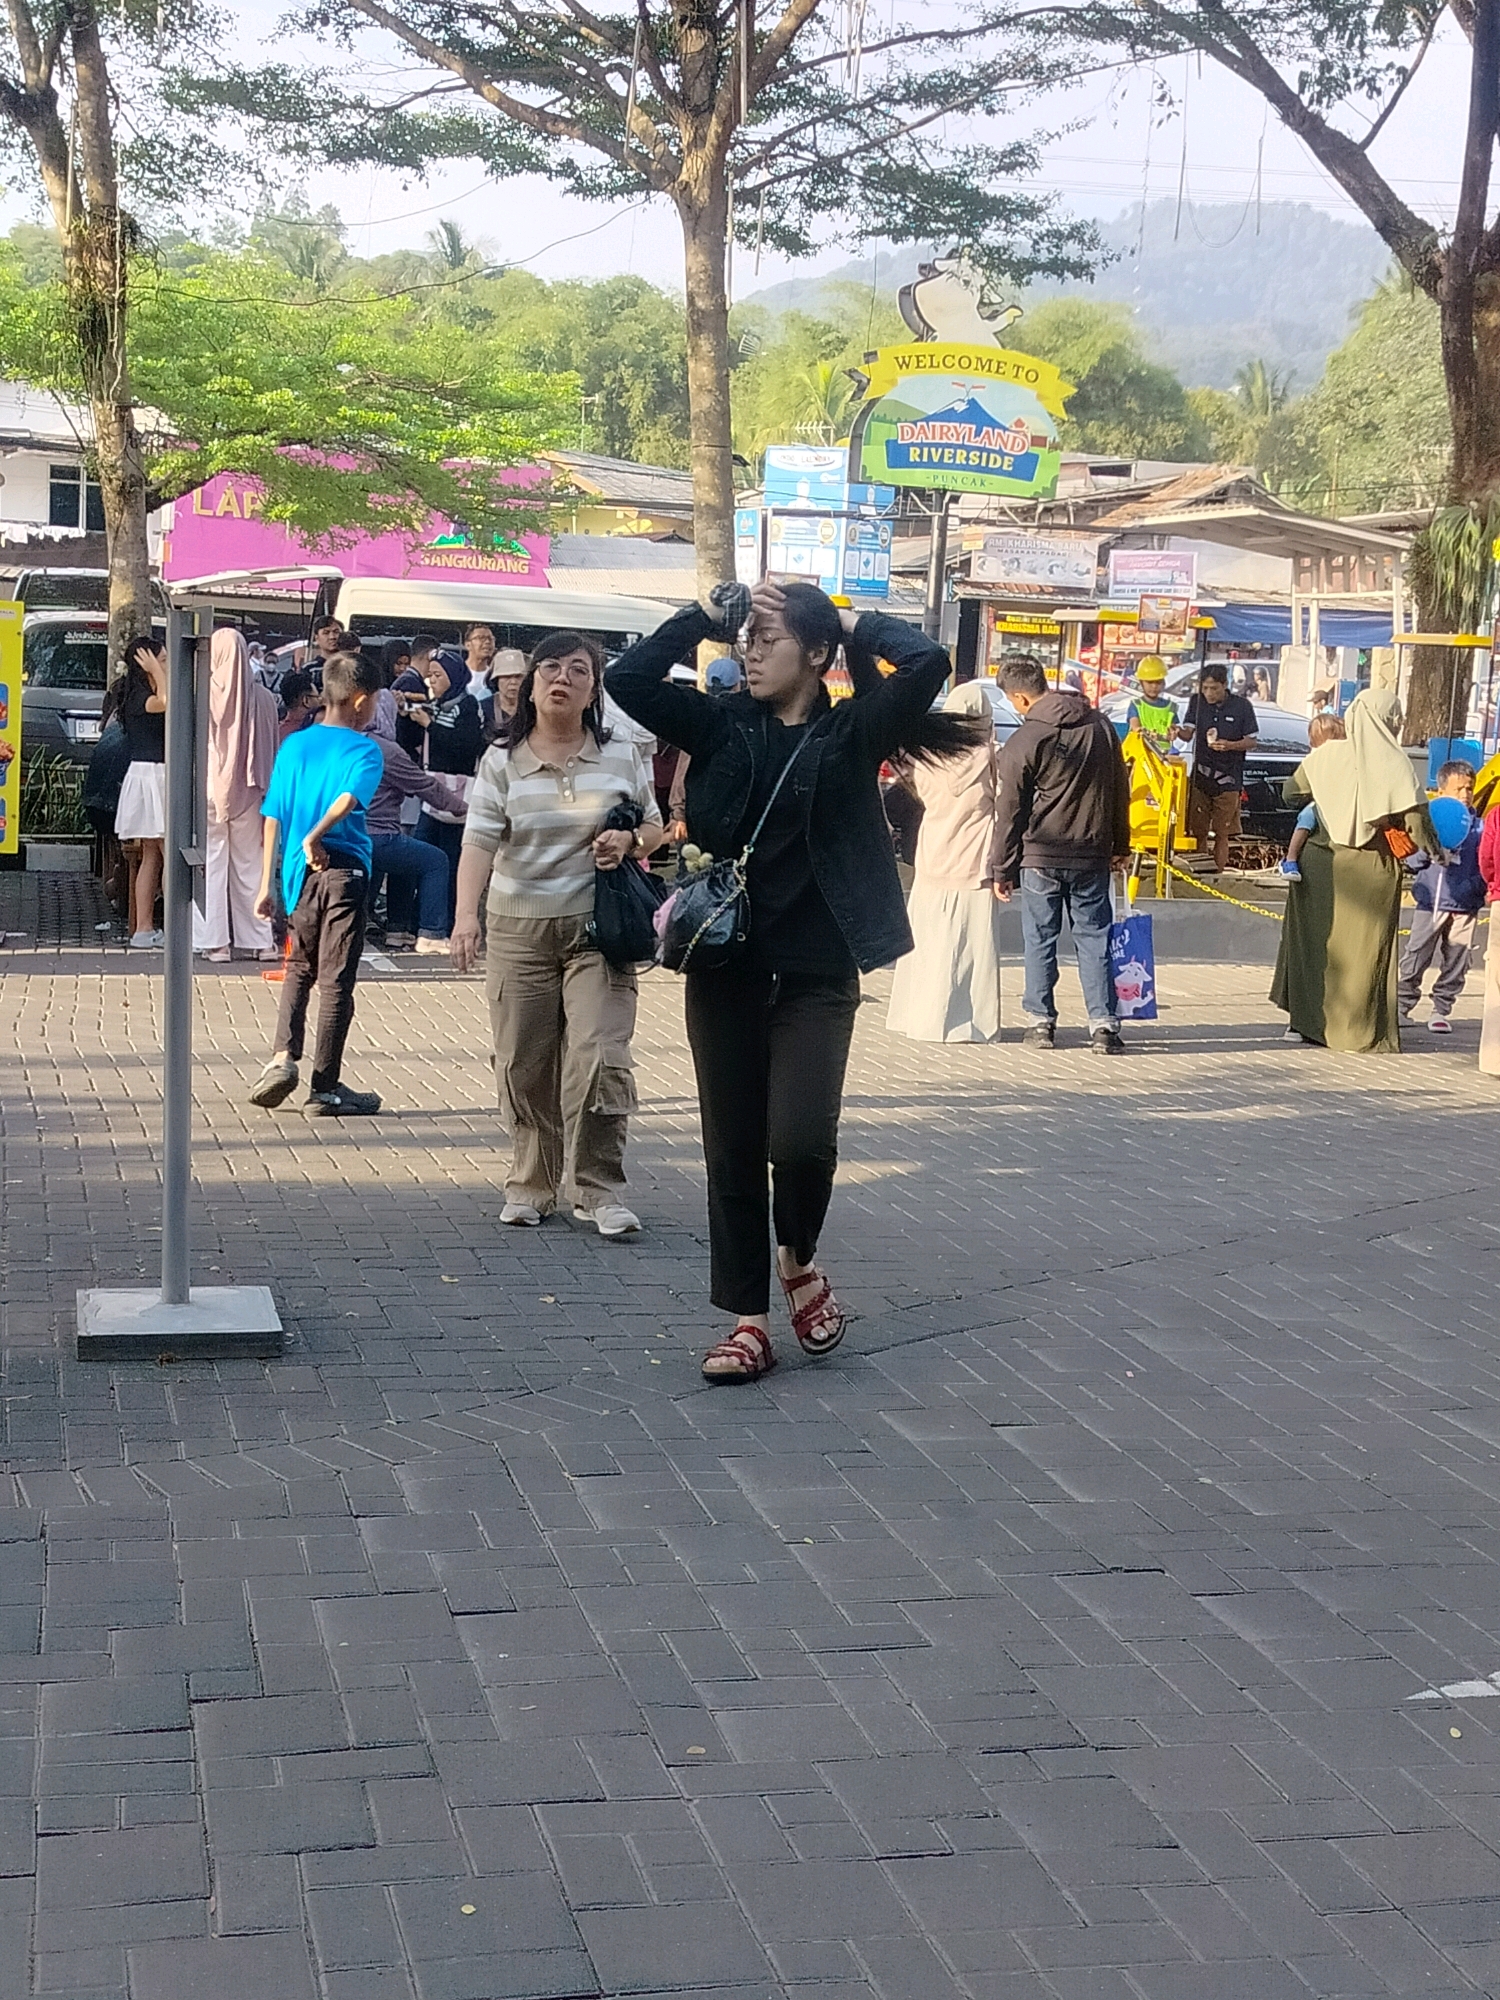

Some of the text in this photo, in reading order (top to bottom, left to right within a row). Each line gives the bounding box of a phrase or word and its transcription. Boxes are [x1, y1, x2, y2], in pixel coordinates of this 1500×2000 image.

[894, 354, 1039, 383] WELCOME TO
[898, 422, 1028, 454] DAIRYLAND
[909, 446, 1014, 471] RIVERSIDE
[193, 486, 265, 518] LAP
[1007, 538, 1055, 550] KHARISMA
[420, 553, 530, 574] SANGKURIANG
[1042, 625, 1060, 635] BAR
